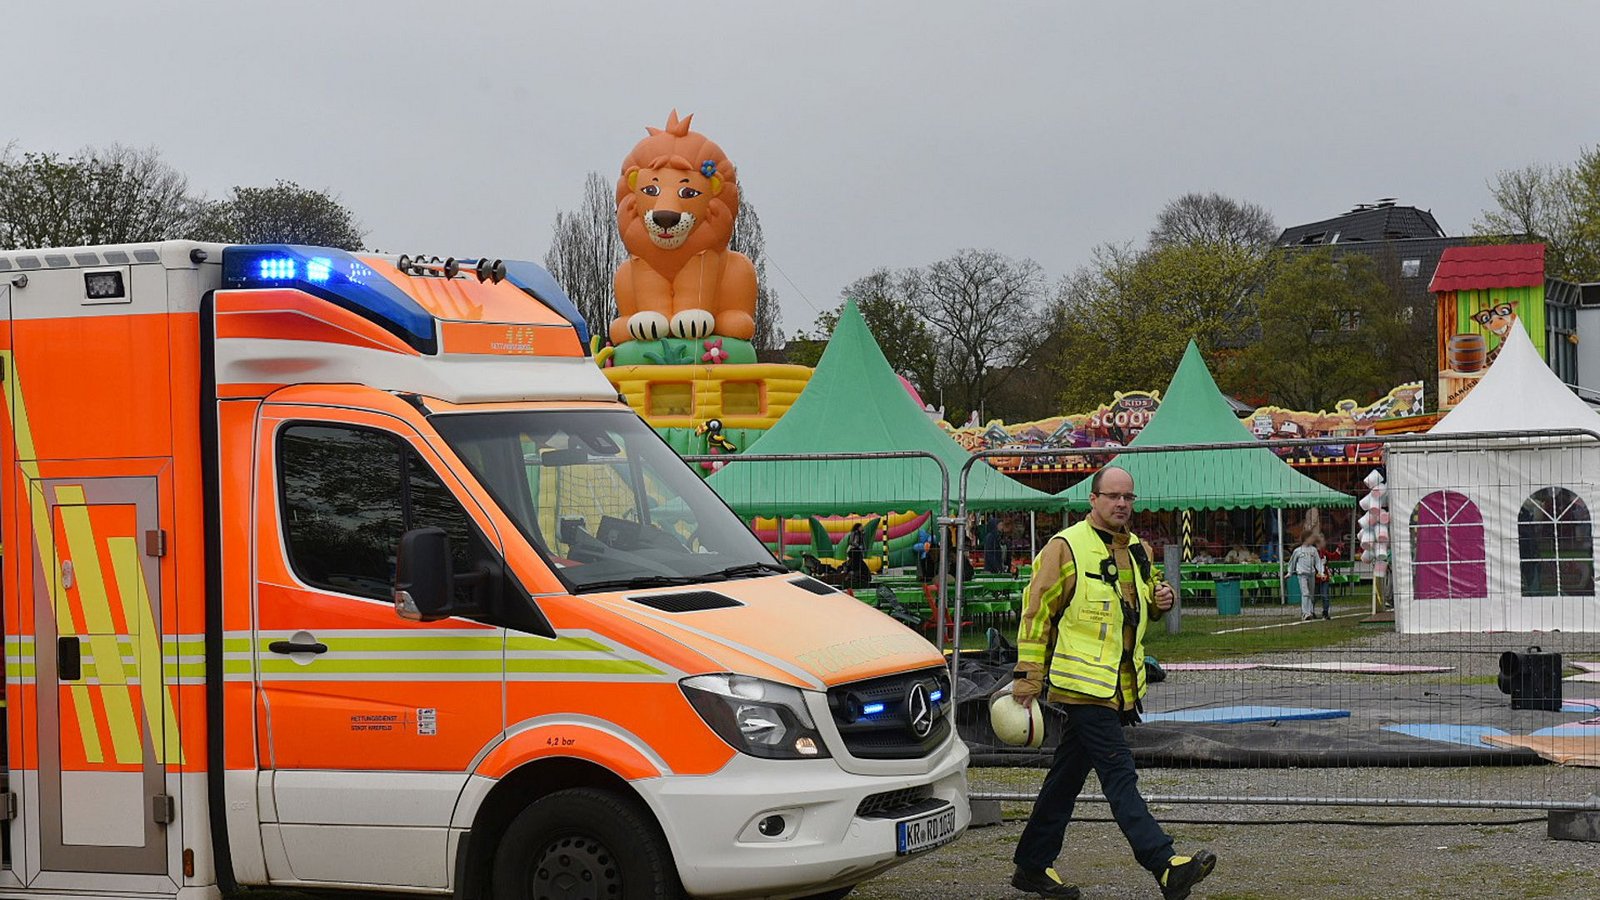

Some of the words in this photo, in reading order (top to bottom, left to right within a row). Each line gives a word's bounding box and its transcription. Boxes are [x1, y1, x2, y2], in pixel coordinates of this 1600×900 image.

[546, 737, 559, 746] 4,2
[562, 736, 576, 746] bar
[906, 822, 920, 847] KR
[927, 818, 938, 841] RD
